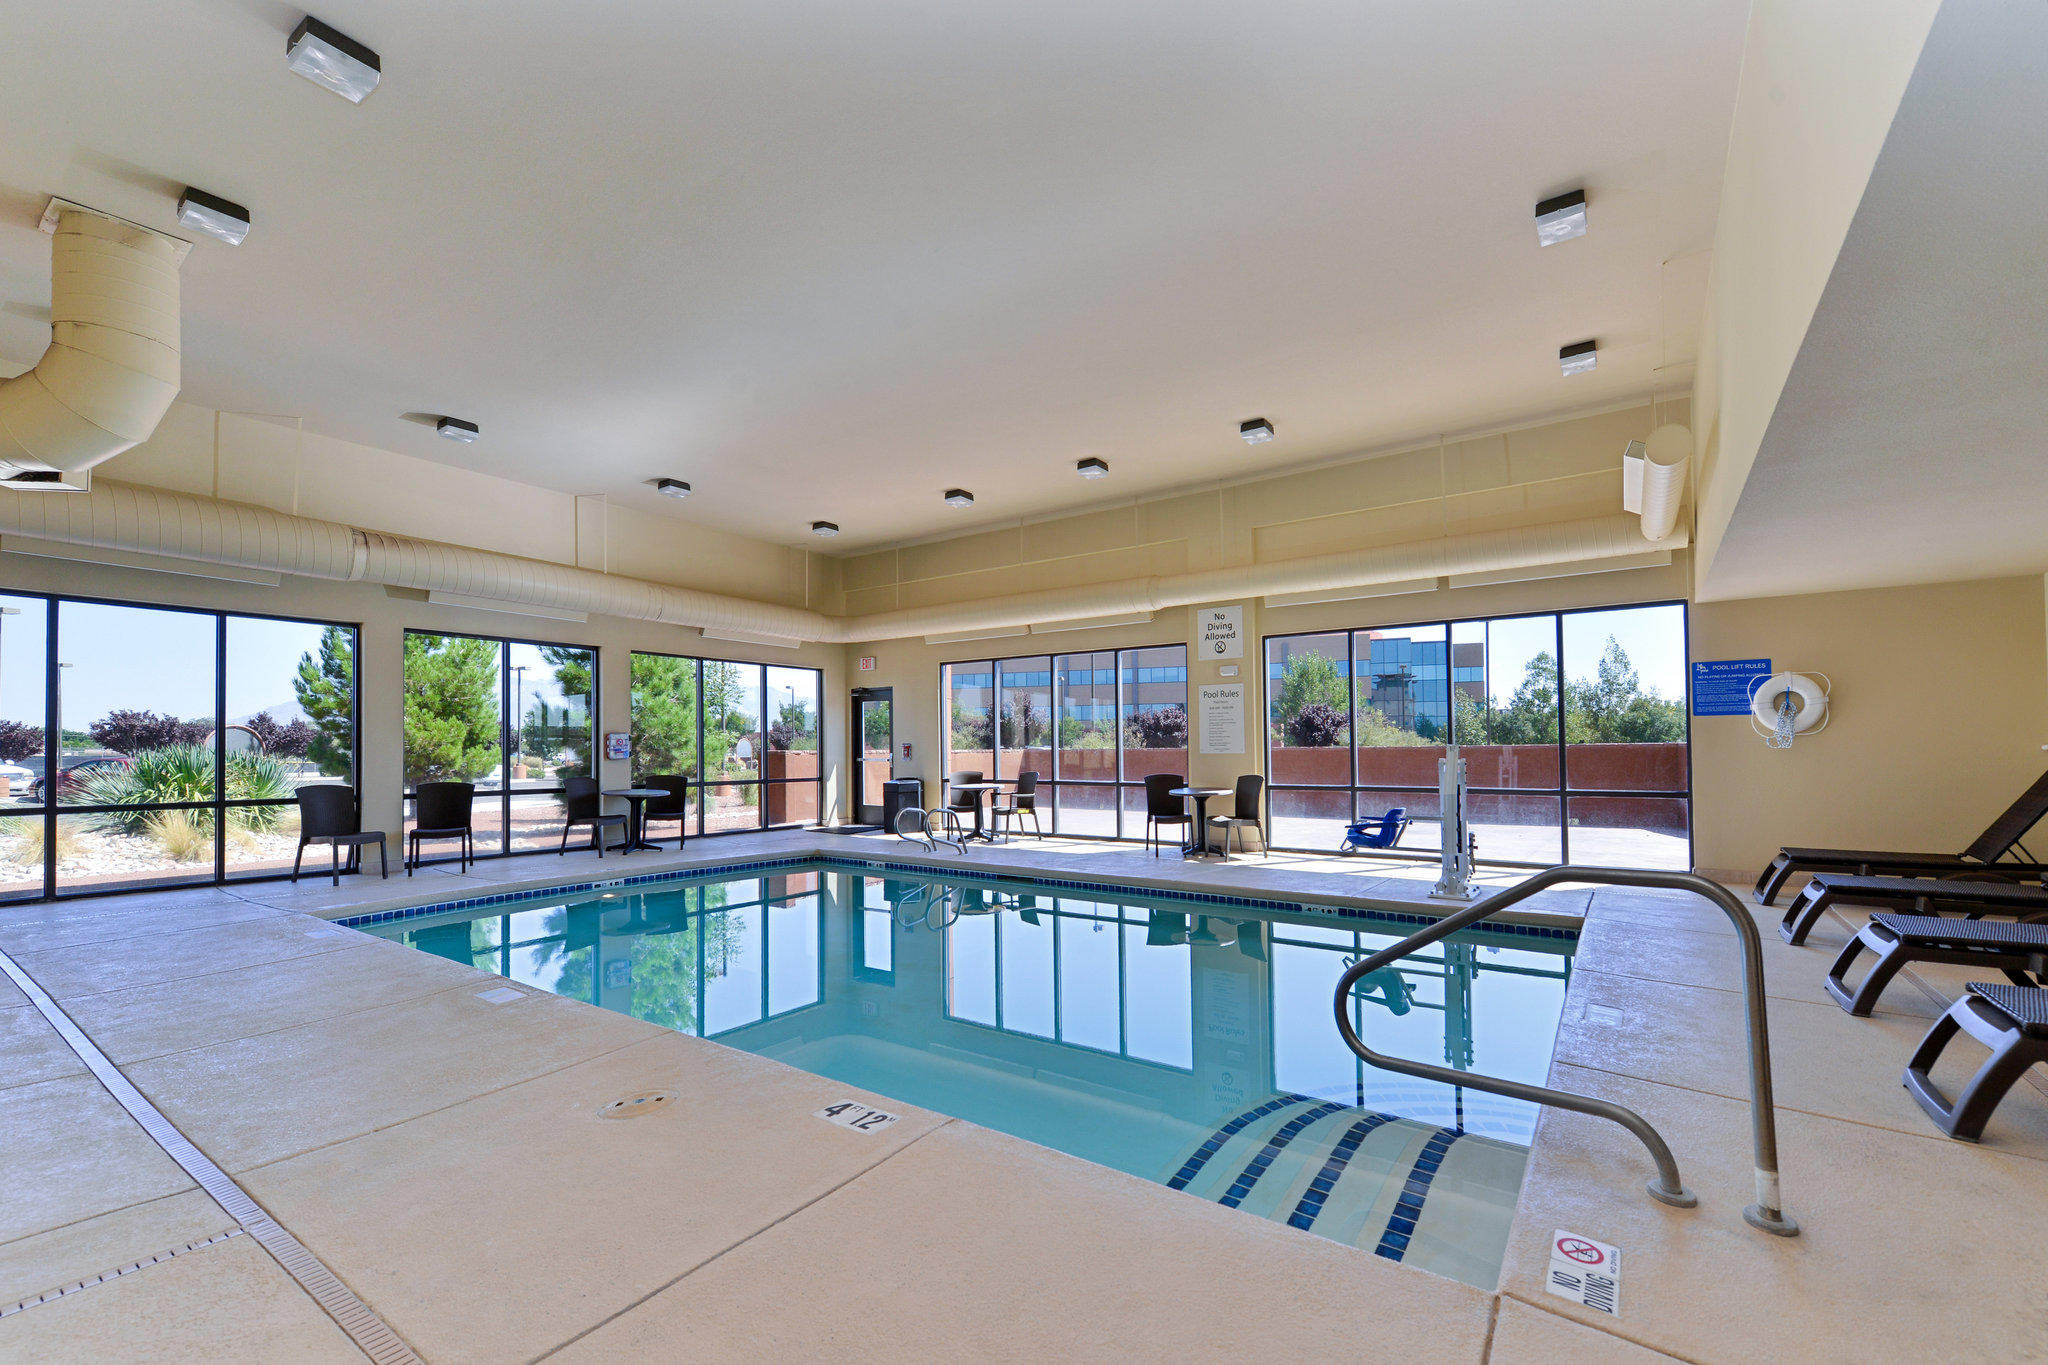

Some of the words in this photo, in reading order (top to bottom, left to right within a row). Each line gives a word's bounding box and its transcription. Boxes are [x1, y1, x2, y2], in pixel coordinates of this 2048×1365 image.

[1207, 622, 1233, 631] Diving
[1204, 631, 1236, 640] Allowed
[862, 658, 872, 669] EXIT
[1203, 690, 1218, 699] Pool
[1220, 690, 1240, 698] Rules
[824, 1102, 853, 1117] 4
[1552, 1271, 1581, 1292] NO
[1583, 1272, 1615, 1314] DIVING
